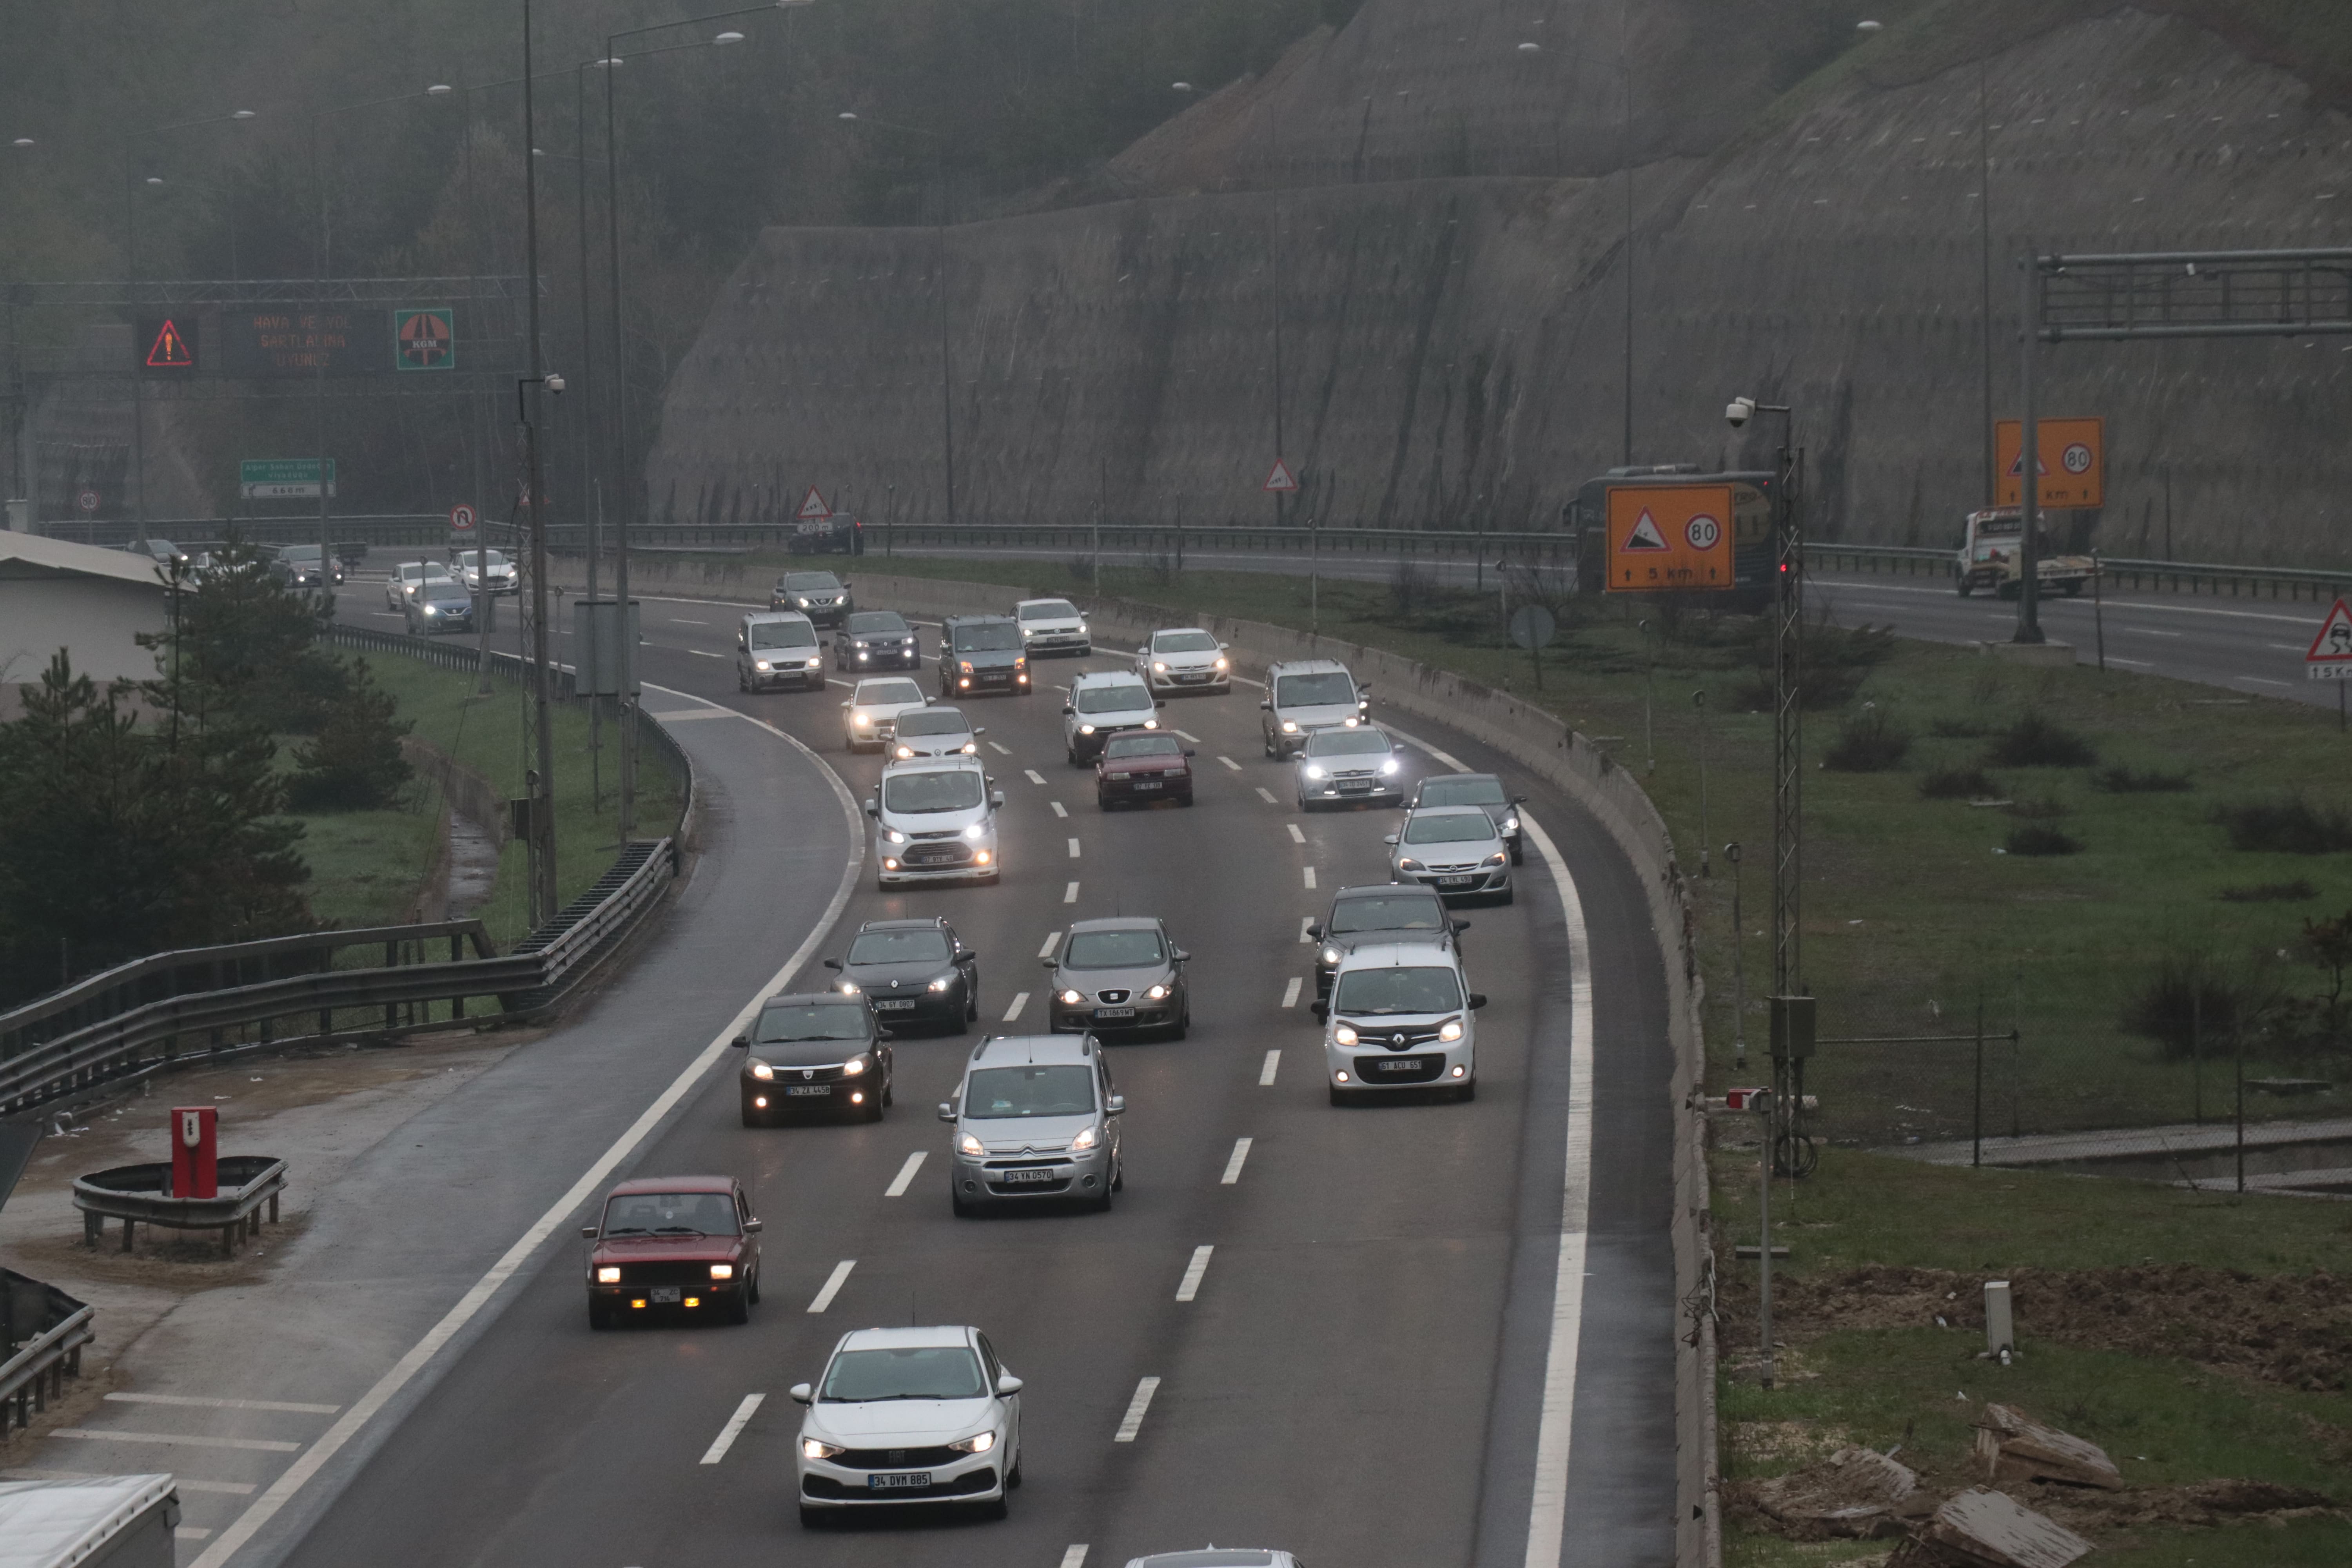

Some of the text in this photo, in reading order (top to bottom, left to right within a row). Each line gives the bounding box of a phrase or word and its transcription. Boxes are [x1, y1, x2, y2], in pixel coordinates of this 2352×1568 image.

[254, 315, 352, 329] HAVA VE YOL
[412, 339, 437, 348] KGM
[2067, 451, 2087, 466] 80
[2046, 490, 2068, 499] km
[83, 496, 95, 506] 80
[1692, 524, 1714, 541] 80
[1649, 568, 1693, 579] 5 km
[1033, 1171, 1051, 1179] 0570
[889, 1450, 906, 1464] FIAT
[875, 1474, 928, 1486] 34 DVM 885
